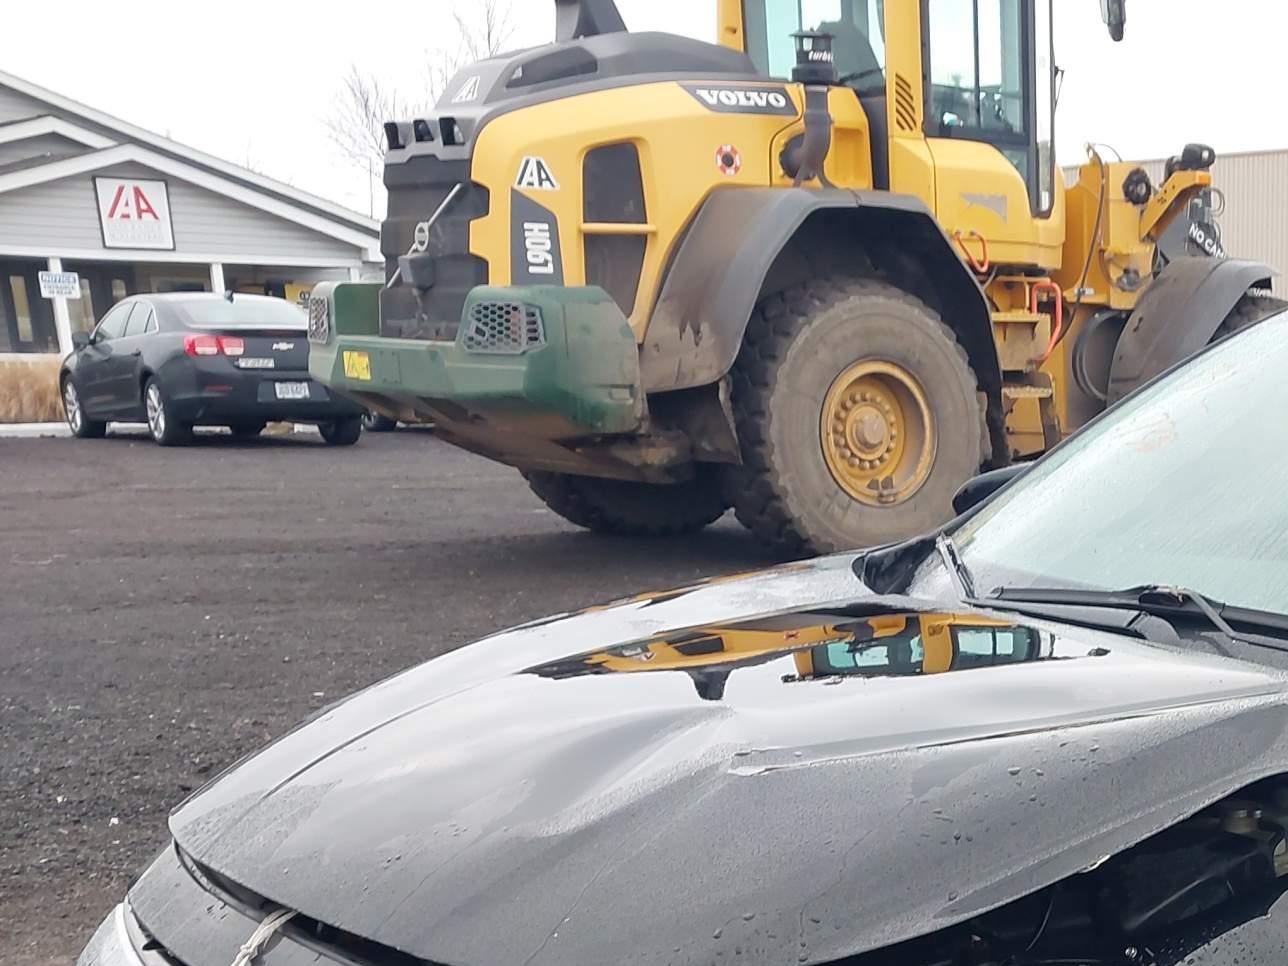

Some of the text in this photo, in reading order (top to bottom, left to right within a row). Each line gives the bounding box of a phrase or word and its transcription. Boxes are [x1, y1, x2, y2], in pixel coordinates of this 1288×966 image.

[696, 89, 786, 108] VOLVO
[1189, 221, 1205, 244] NO
[523, 222, 554, 274] L90H
